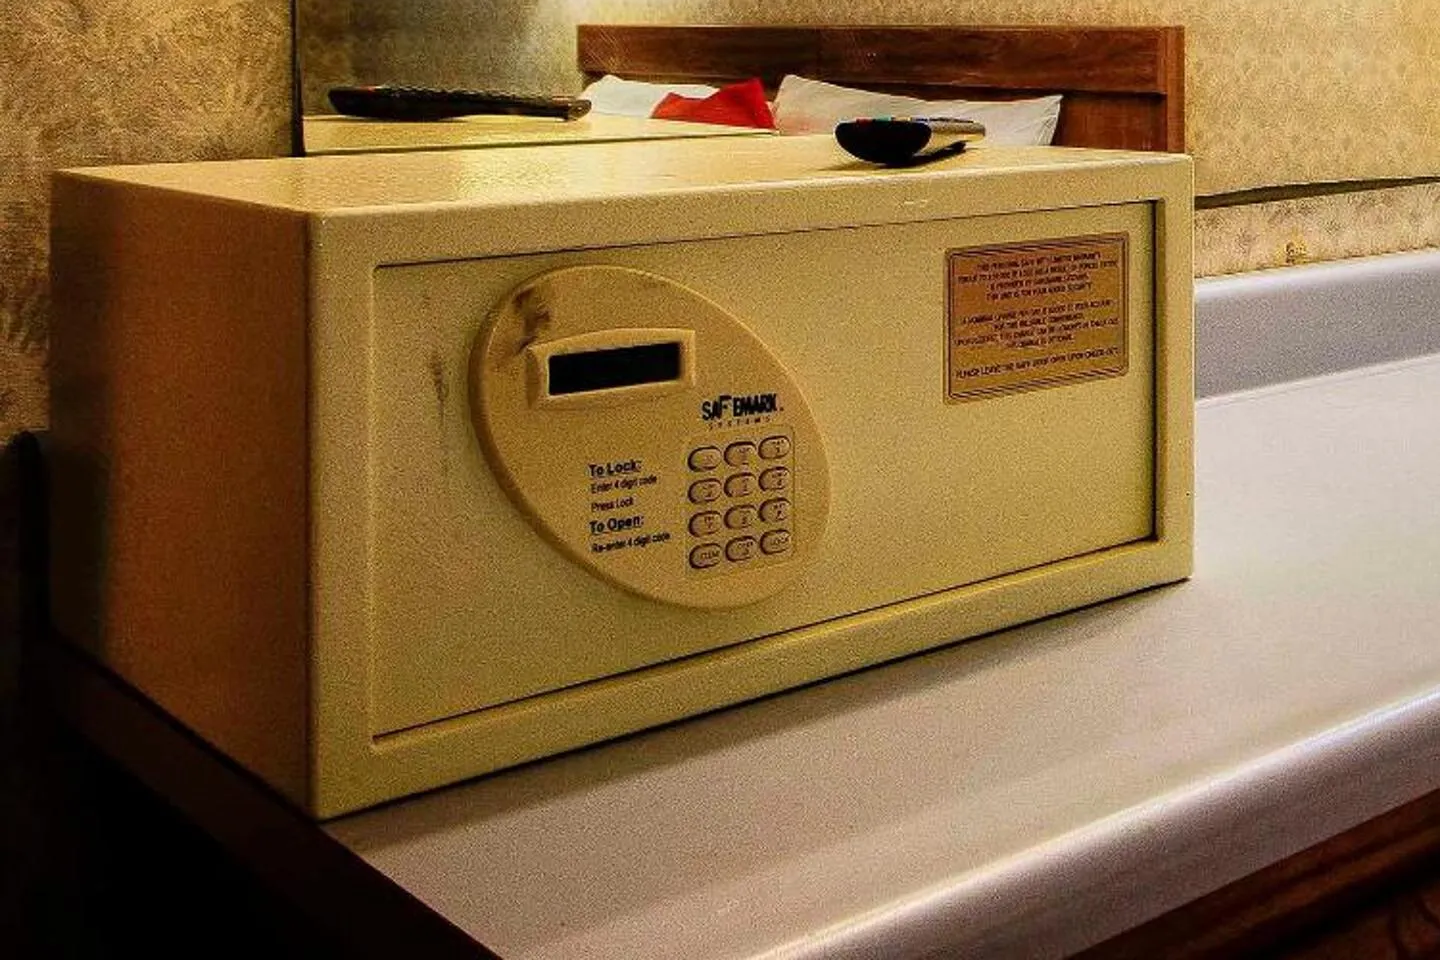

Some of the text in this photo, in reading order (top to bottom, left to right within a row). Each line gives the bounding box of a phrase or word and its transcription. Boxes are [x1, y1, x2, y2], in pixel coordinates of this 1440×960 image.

[589, 463, 605, 477] To
[589, 515, 644, 534] To Open:
